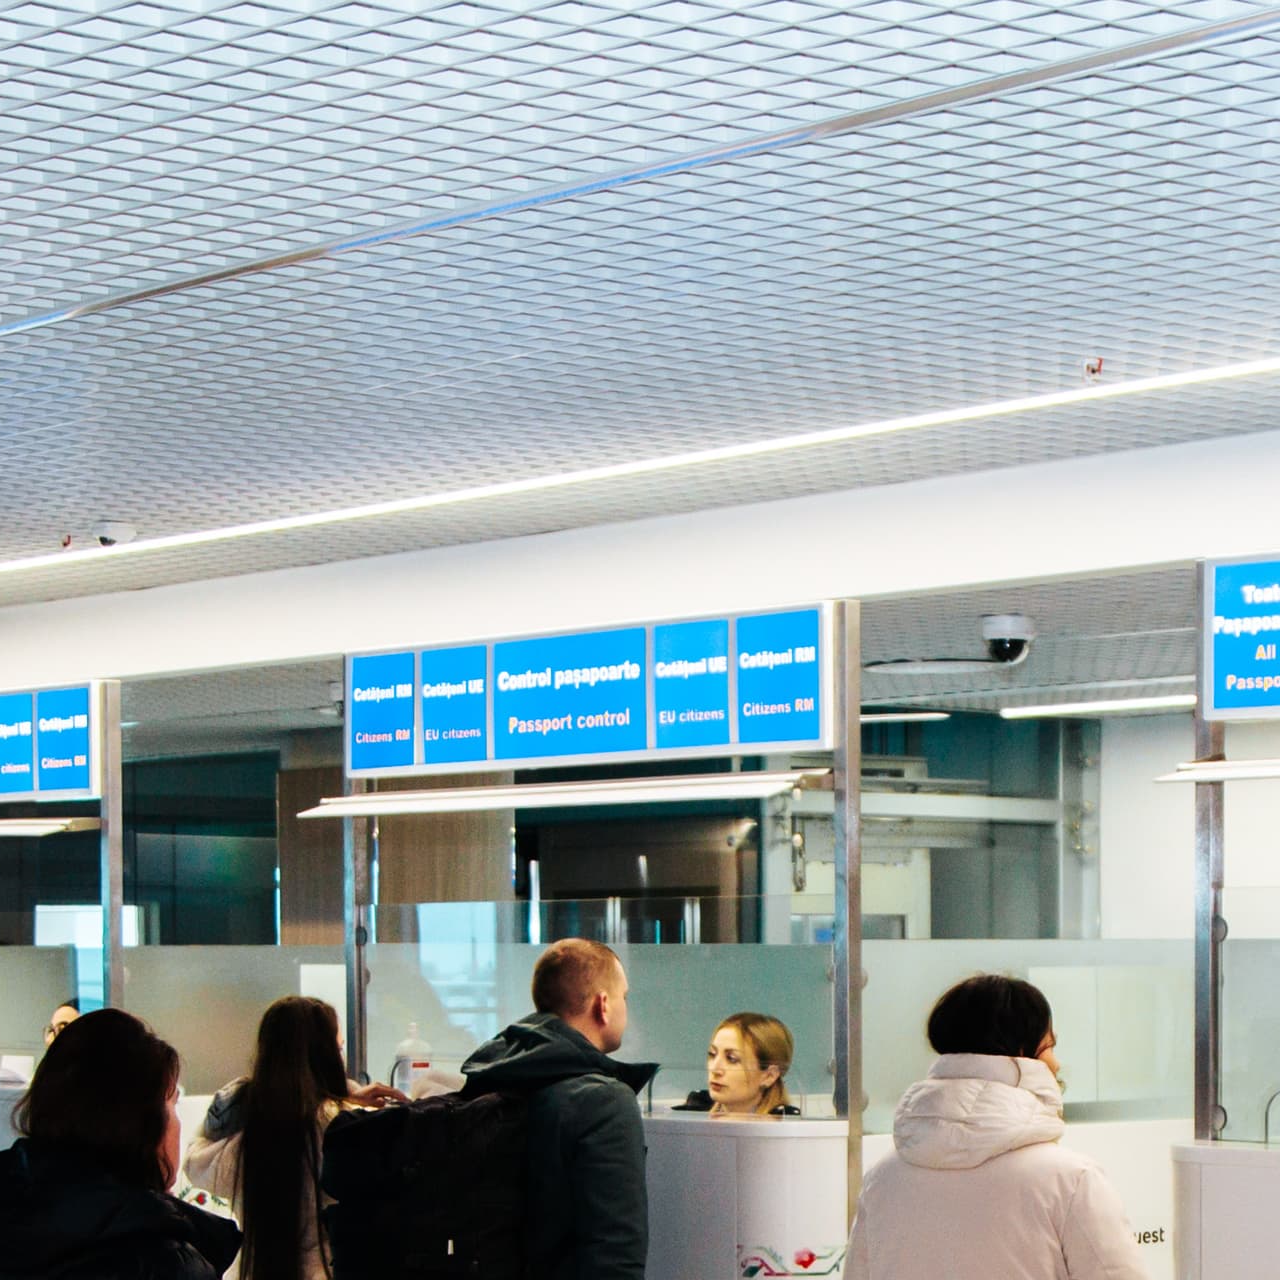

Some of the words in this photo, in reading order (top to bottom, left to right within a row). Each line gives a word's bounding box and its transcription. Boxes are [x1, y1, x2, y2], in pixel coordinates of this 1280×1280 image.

[794, 646, 815, 662] RM
[1255, 645, 1276, 660] All
[468, 679, 483, 693] UE
[498, 668, 551, 691] Control
[743, 703, 791, 716] Citizens
[795, 698, 814, 711] RM
[509, 715, 572, 735] Passport
[577, 708, 630, 728] control
[659, 711, 675, 724] EU
[679, 710, 724, 722] citizens
[356, 733, 392, 743] Citizens
[425, 730, 439, 740] EU
[443, 729, 481, 739] citizens
